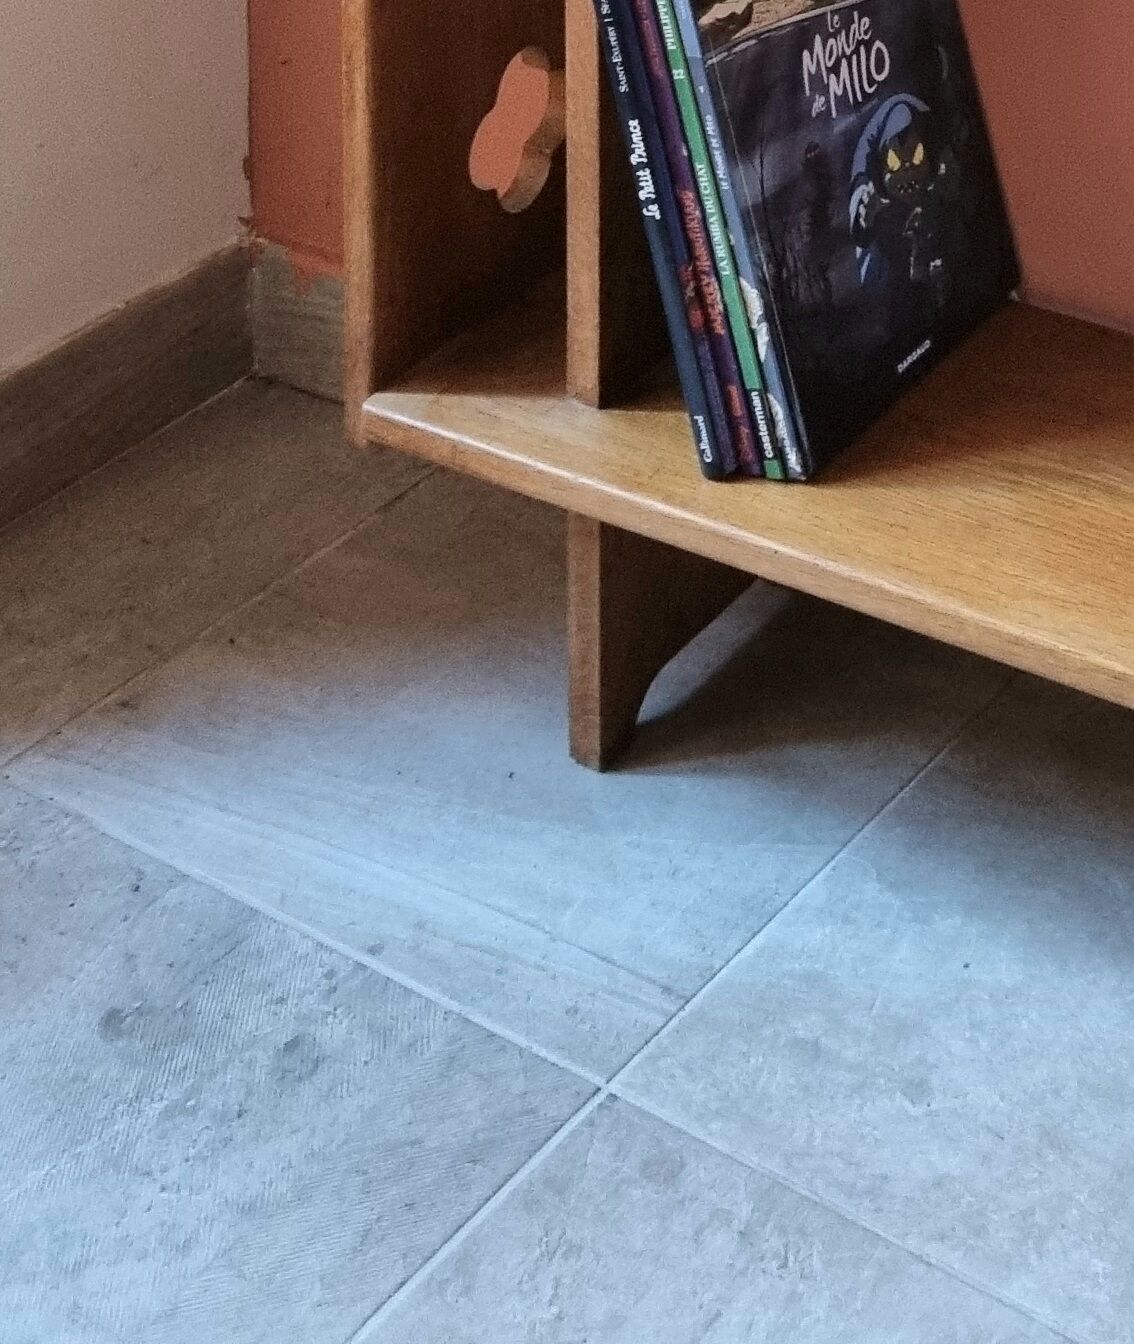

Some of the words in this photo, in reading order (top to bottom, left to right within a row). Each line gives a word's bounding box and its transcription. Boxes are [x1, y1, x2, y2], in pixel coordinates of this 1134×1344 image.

[802, 10, 872, 97] Monde
[812, 94, 827, 118] de
[829, 39, 890, 119] MILO
[628, 119, 647, 165] Prince
[636, 169, 654, 200] Petit
[750, 391, 773, 457] casterman
